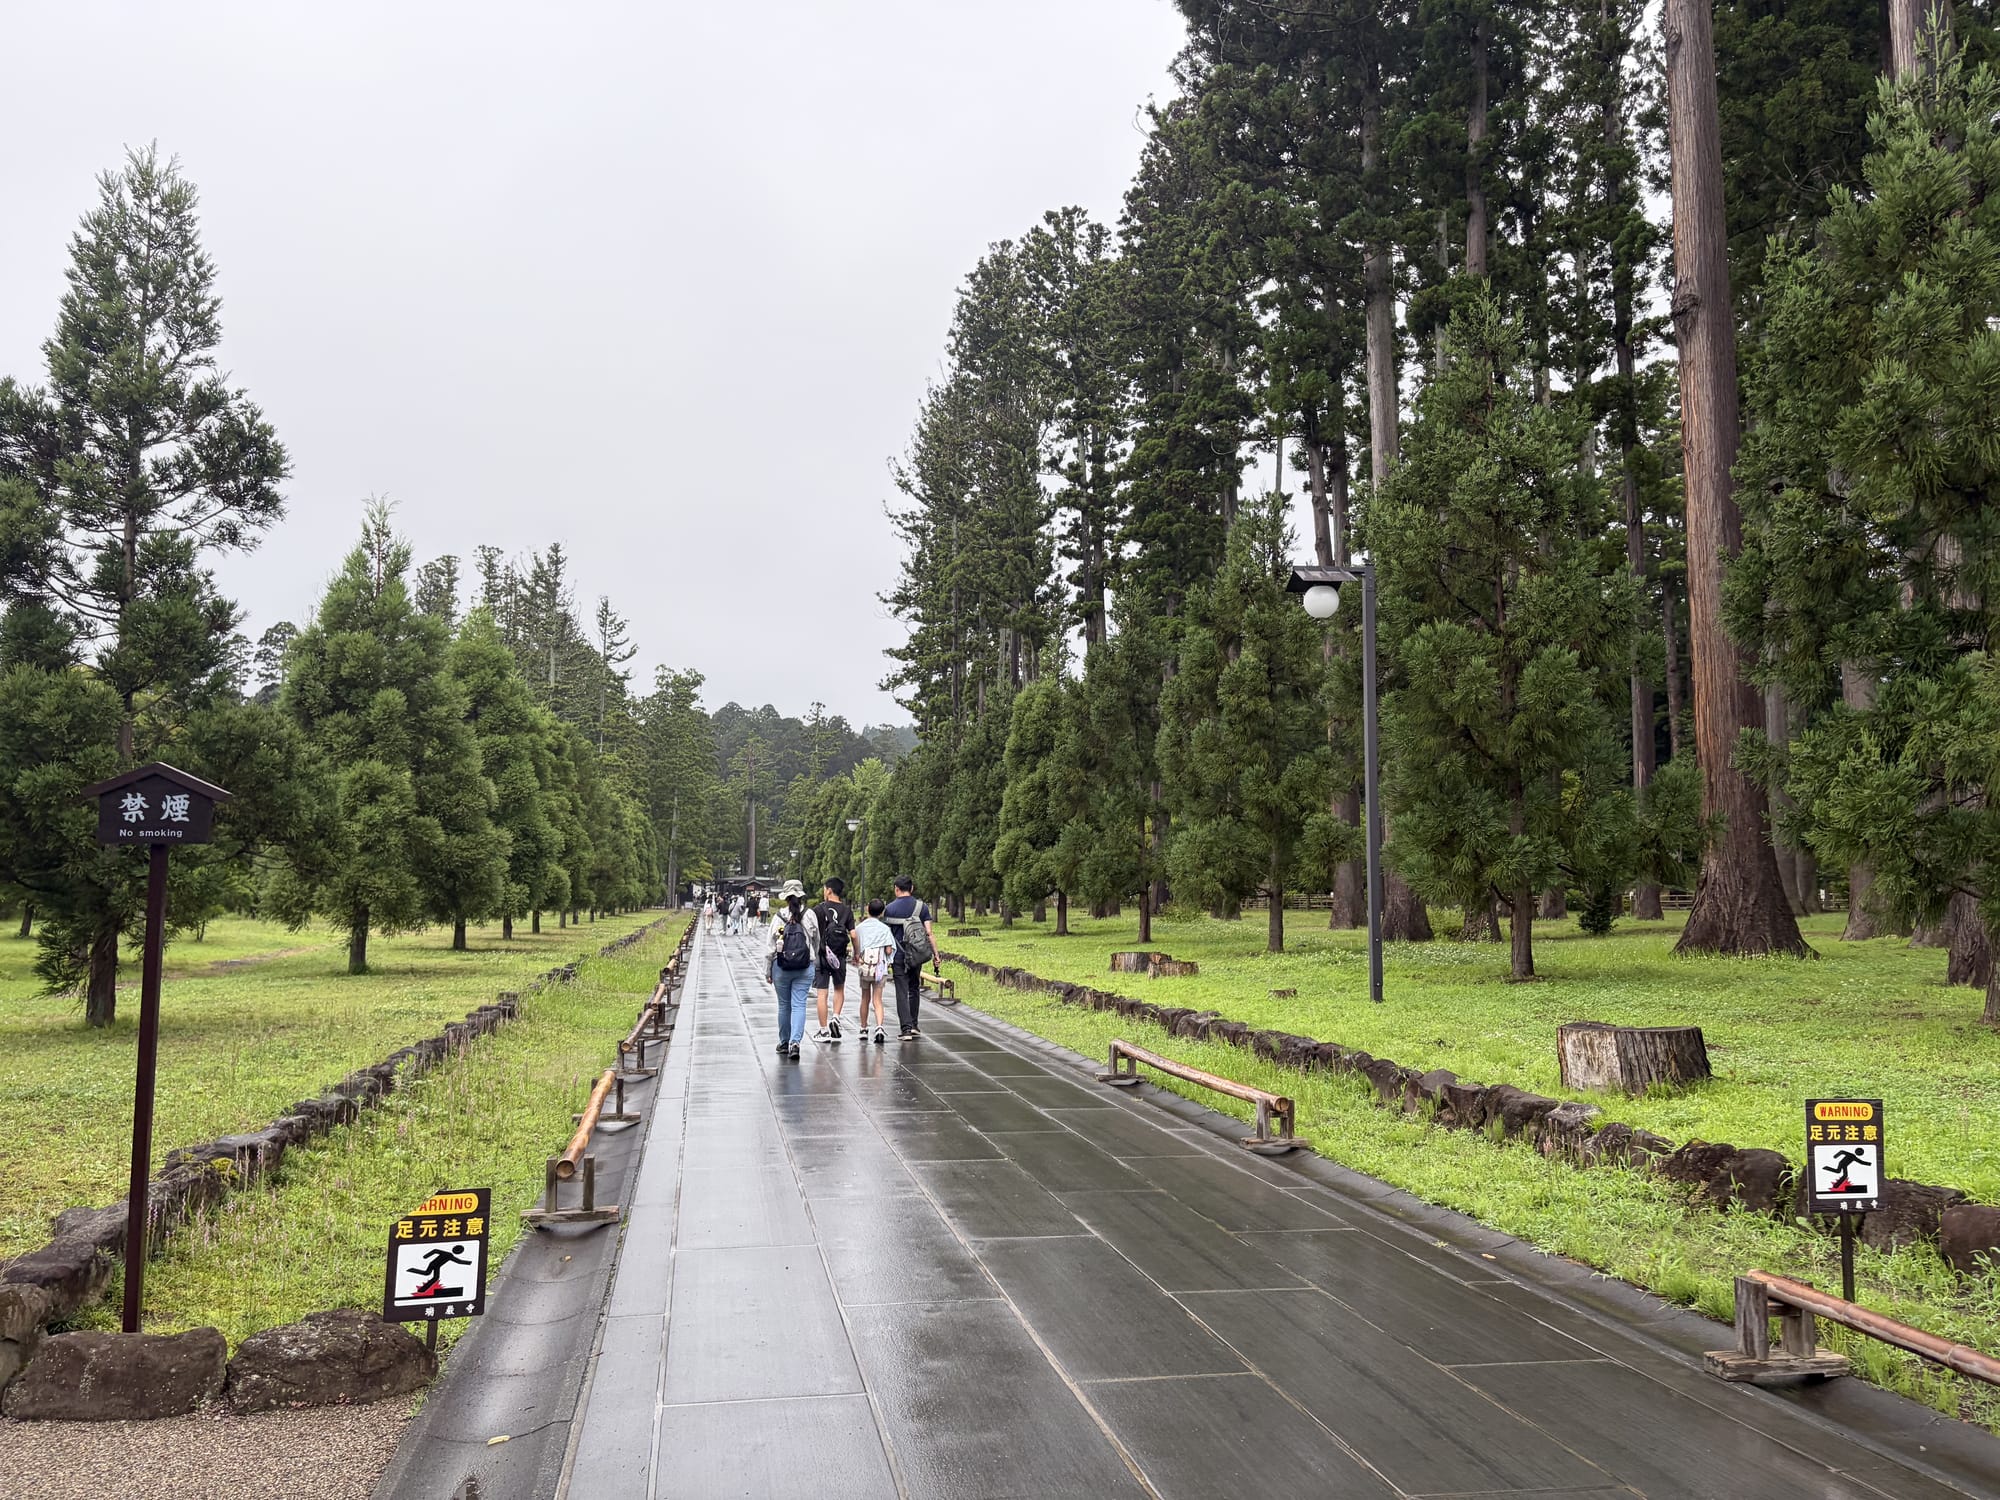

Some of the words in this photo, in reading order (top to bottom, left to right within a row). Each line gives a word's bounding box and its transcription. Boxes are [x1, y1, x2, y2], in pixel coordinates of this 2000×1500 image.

[118, 792, 191, 823] 禁煙
[119, 829, 134, 837] No
[139, 829, 183, 838] smoking
[1819, 1106, 1869, 1117] WARNING
[1809, 1125, 1878, 1141] 足元注意
[414, 1197, 473, 1211] ARNING
[395, 1217, 484, 1239] 足元注意
